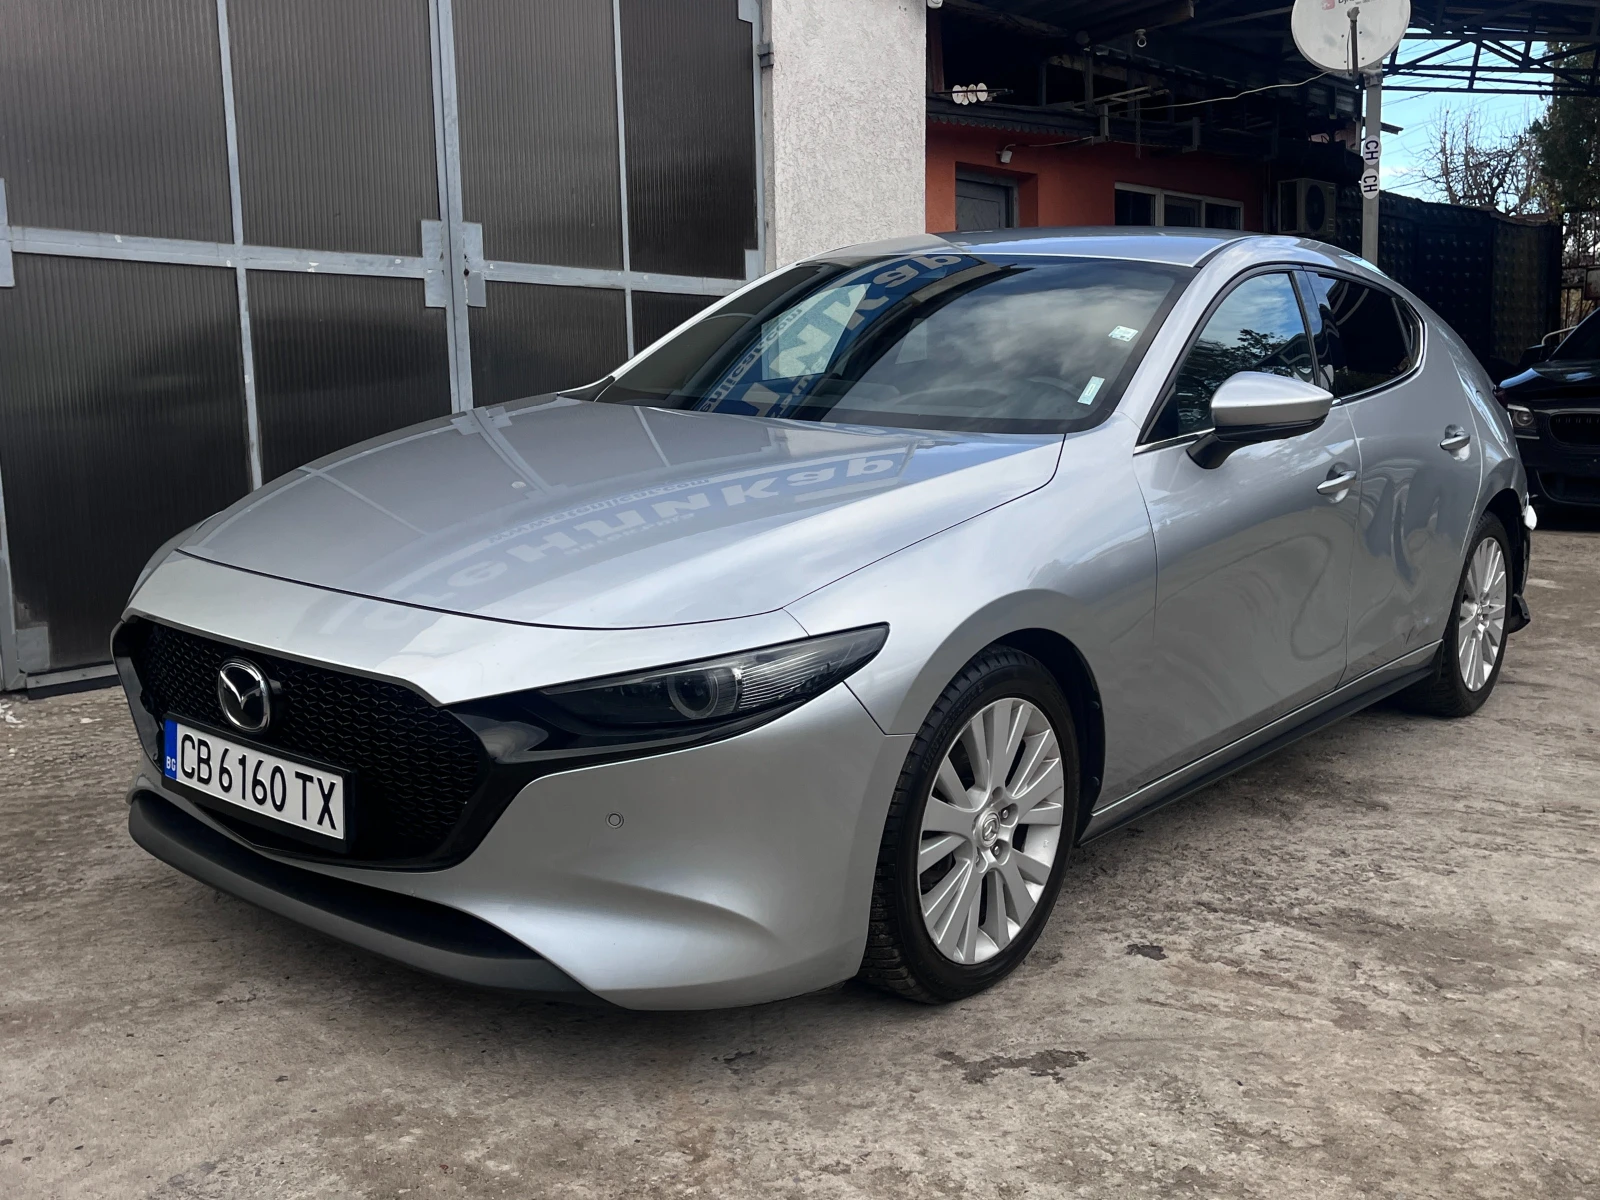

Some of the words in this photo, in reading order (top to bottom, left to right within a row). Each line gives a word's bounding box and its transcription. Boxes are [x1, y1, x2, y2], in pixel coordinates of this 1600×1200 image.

[1365, 140, 1379, 160] CH
[1363, 175, 1378, 193] CH
[166, 755, 176, 771] BG
[180, 733, 213, 786] CB
[218, 747, 287, 812] 6160
[294, 770, 337, 831] TX
